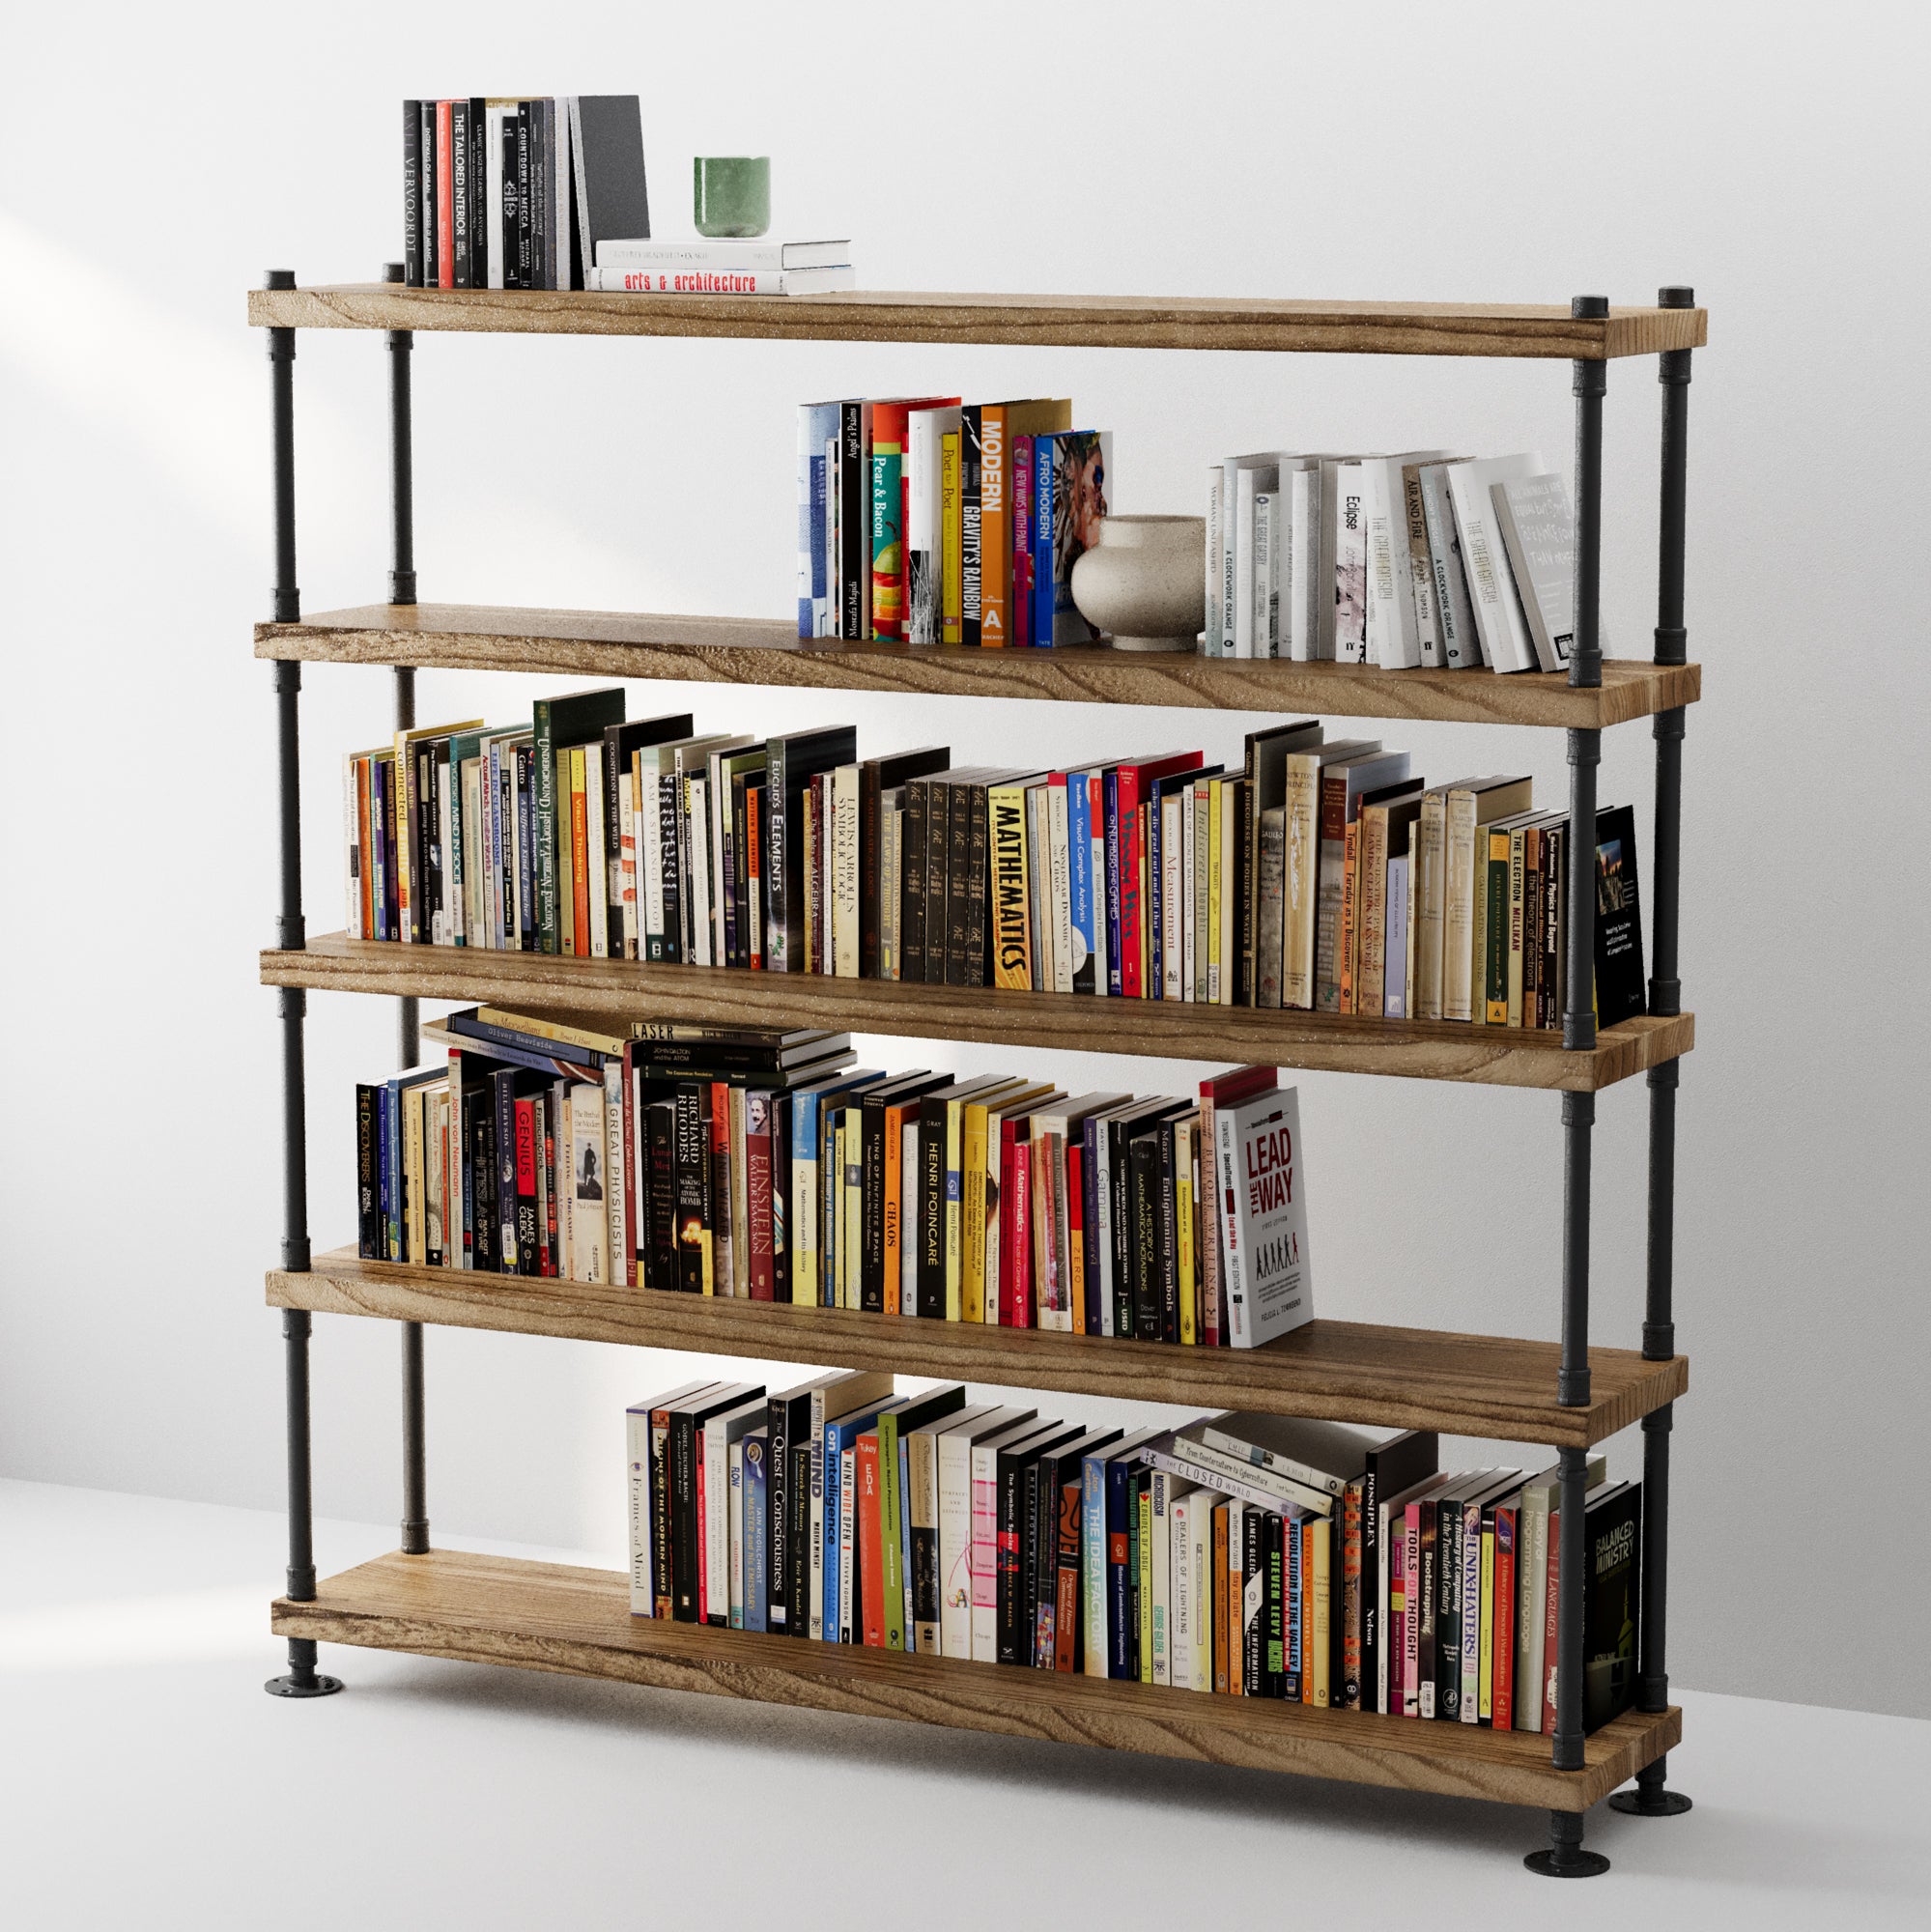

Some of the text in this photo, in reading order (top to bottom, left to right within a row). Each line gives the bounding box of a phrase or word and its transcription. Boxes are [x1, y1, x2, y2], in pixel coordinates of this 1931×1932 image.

[455, 114, 465, 235] THE TAILORED INTERIOR
[405, 157, 416, 254] VERVOORDT
[625, 273, 755, 292] arts & architecture
[982, 421, 1001, 511] MODERN
[1039, 452, 1050, 539] AFRO MODERN
[1407, 480, 1419, 497] AIR
[874, 458, 887, 537] Pear & Bacon
[1016, 469, 1027, 552] NEW WAYS WITH PAINT
[1347, 497, 1360, 529] Eclipse
[963, 506, 980, 620] GRAVITY'S RAINBOW
[538, 738, 552, 807] UNDERGROUND
[611, 793, 616, 804] IN
[396, 752, 409, 873] connected family
[539, 810, 552, 842] HISTORY
[772, 760, 783, 891] EUCLID'S ELEMENTS
[540, 848, 553, 887] AMERICAN
[1198, 809, 1207, 881] Indiscrete
[541, 891, 554, 931] EDUCATION
[996, 806, 1026, 971] MATHEMATICS
[1167, 857, 1177, 949] Measurement
[1345, 873, 1353, 904] Faraday
[1527, 895, 1536, 923] theory
[1512, 907, 1520, 951] MILLIKAN
[1528, 929, 1536, 939] of
[1526, 943, 1535, 986] electrons
[633, 1023, 674, 1039] LASER
[361, 1091, 371, 1181] THE DISCOVERERS
[519, 1112, 530, 1176] GENIUS
[678, 1094, 688, 1162] RHODES
[689, 1095, 698, 1163] RICHARD
[1246, 1127, 1292, 1179] LEAD
[611, 1167, 621, 1260] PHYSICISTS
[718, 1141, 728, 1243] WIND WIZARD
[757, 1155, 770, 1256] EINSTEIN
[928, 1143, 939, 1265] HENRI POINCARÉ
[1097, 1169, 1109, 1229] Gamma
[1251, 1181, 1260, 1218] THE
[1258, 1166, 1293, 1214] WAY
[519, 1207, 527, 1242] GLEICK
[526, 1208, 535, 1244] JAMES
[887, 1202, 895, 1247] CHAOS
[1148, 1251, 1154, 1262] OF
[1207, 1223, 1216, 1296] WRITING
[774, 1435, 784, 1478] Quest
[811, 1439, 822, 1498] MIND
[828, 1431, 836, 1451] on
[731, 1466, 740, 1487] FLOW
[826, 1453, 838, 1545] intelligence
[1153, 1475, 1164, 1516] MICROCOSM
[1178, 1463, 1223, 1488] CLOSED
[1226, 1483, 1251, 1497] WORLD
[633, 1478, 643, 1589] Frames of Mind
[774, 1491, 784, 1591] Consciousness
[1290, 1523, 1298, 1588] REVOLUTION
[1534, 1512, 1545, 1560] History of
[1596, 1520, 1633, 1555] BALANCED
[1596, 1537, 1633, 1575] MINISTRY
[1090, 1506, 1101, 1654] THE IDEA FACTORY
[1180, 1567, 1186, 1577] OF
[1290, 1592, 1298, 1604] IN
[1421, 1552, 1433, 1635] Bootstrapping
[1464, 1543, 1477, 1655] UNIX-HATERS
[1522, 1510, 1533, 1653] Programming Languages
[1154, 1605, 1164, 1653] GEORGE GILDER
[1268, 1552, 1283, 1672] STEVEN LEVY HACKERS
[1547, 1577, 1558, 1637] LANGUAGES
[1290, 1630, 1298, 1667] VALLEY
